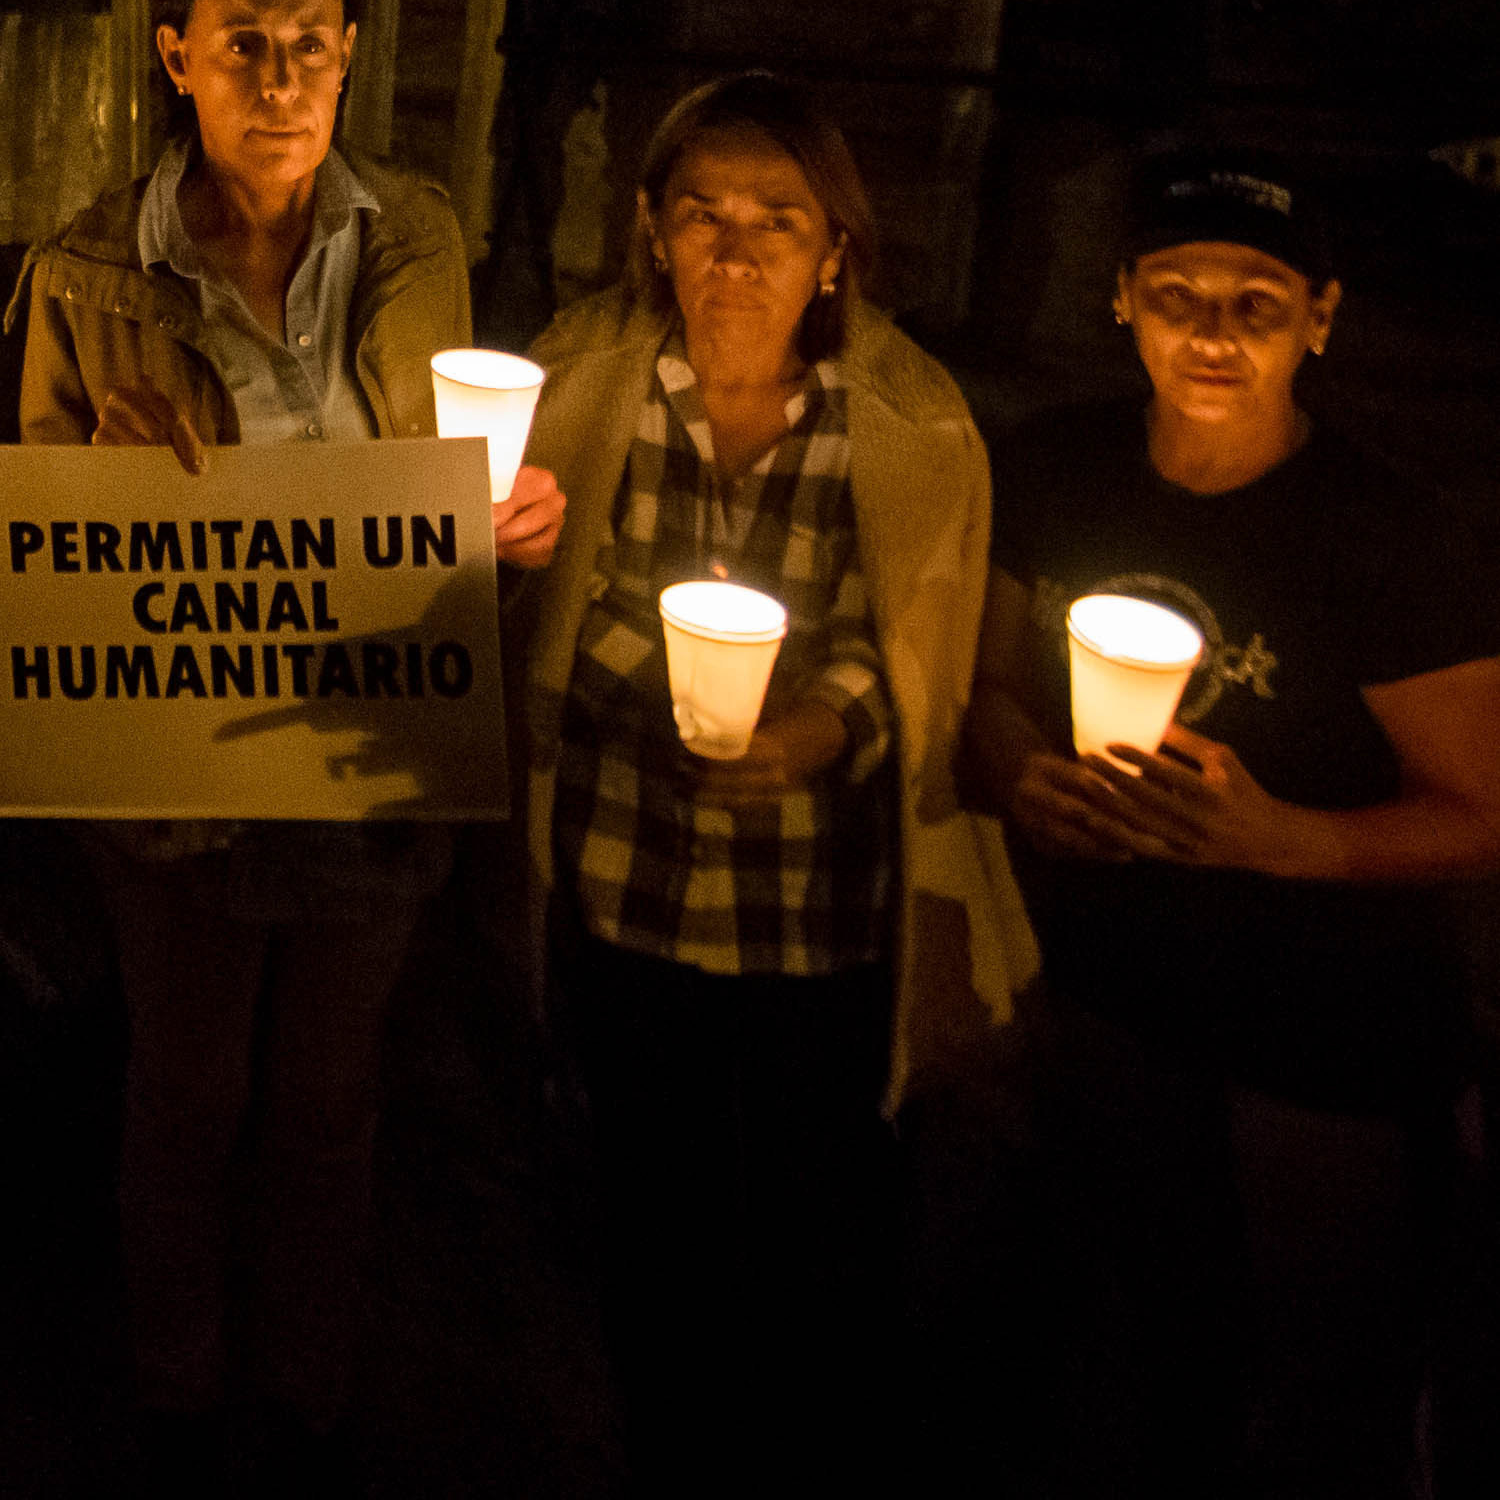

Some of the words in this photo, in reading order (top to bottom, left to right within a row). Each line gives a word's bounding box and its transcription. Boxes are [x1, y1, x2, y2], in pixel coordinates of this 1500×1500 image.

[8, 517, 338, 574] PERMITAN
[362, 513, 458, 568] UN
[132, 580, 340, 634] CANAL
[10, 642, 474, 701] HUMANITARIO
